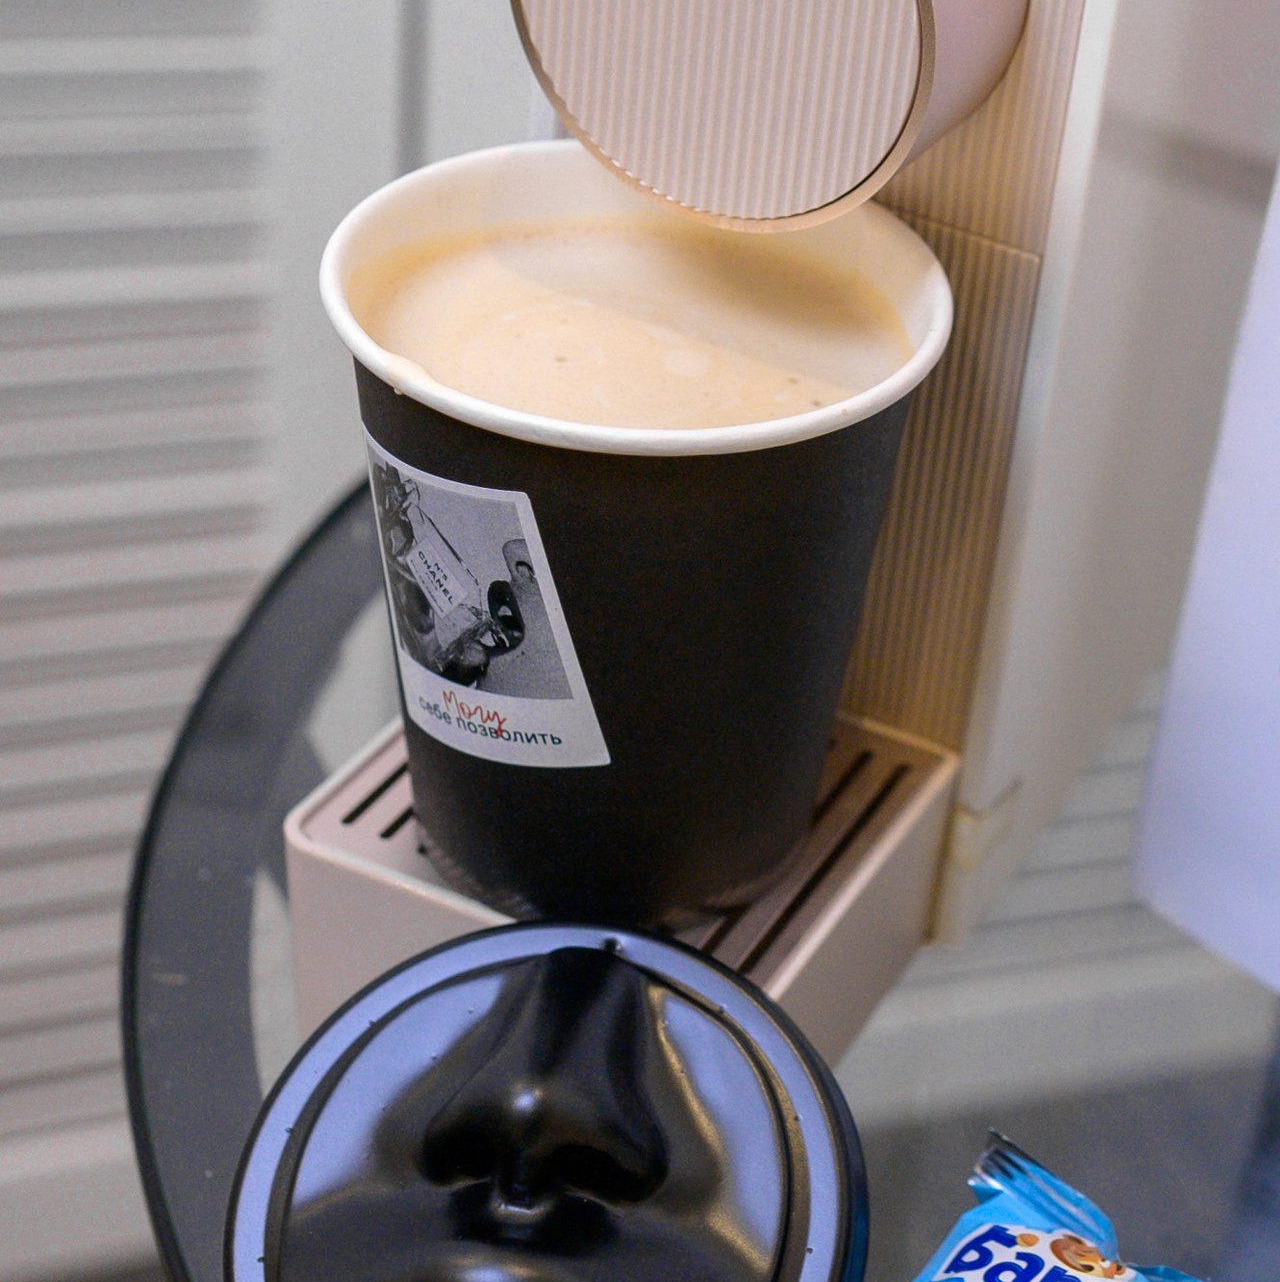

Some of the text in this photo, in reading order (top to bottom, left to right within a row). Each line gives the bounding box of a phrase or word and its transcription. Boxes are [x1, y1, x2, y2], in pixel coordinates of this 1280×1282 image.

[418, 551, 453, 605] CHANEL
[418, 696, 562, 746] себе позволить
[443, 690, 507, 738] Могу
